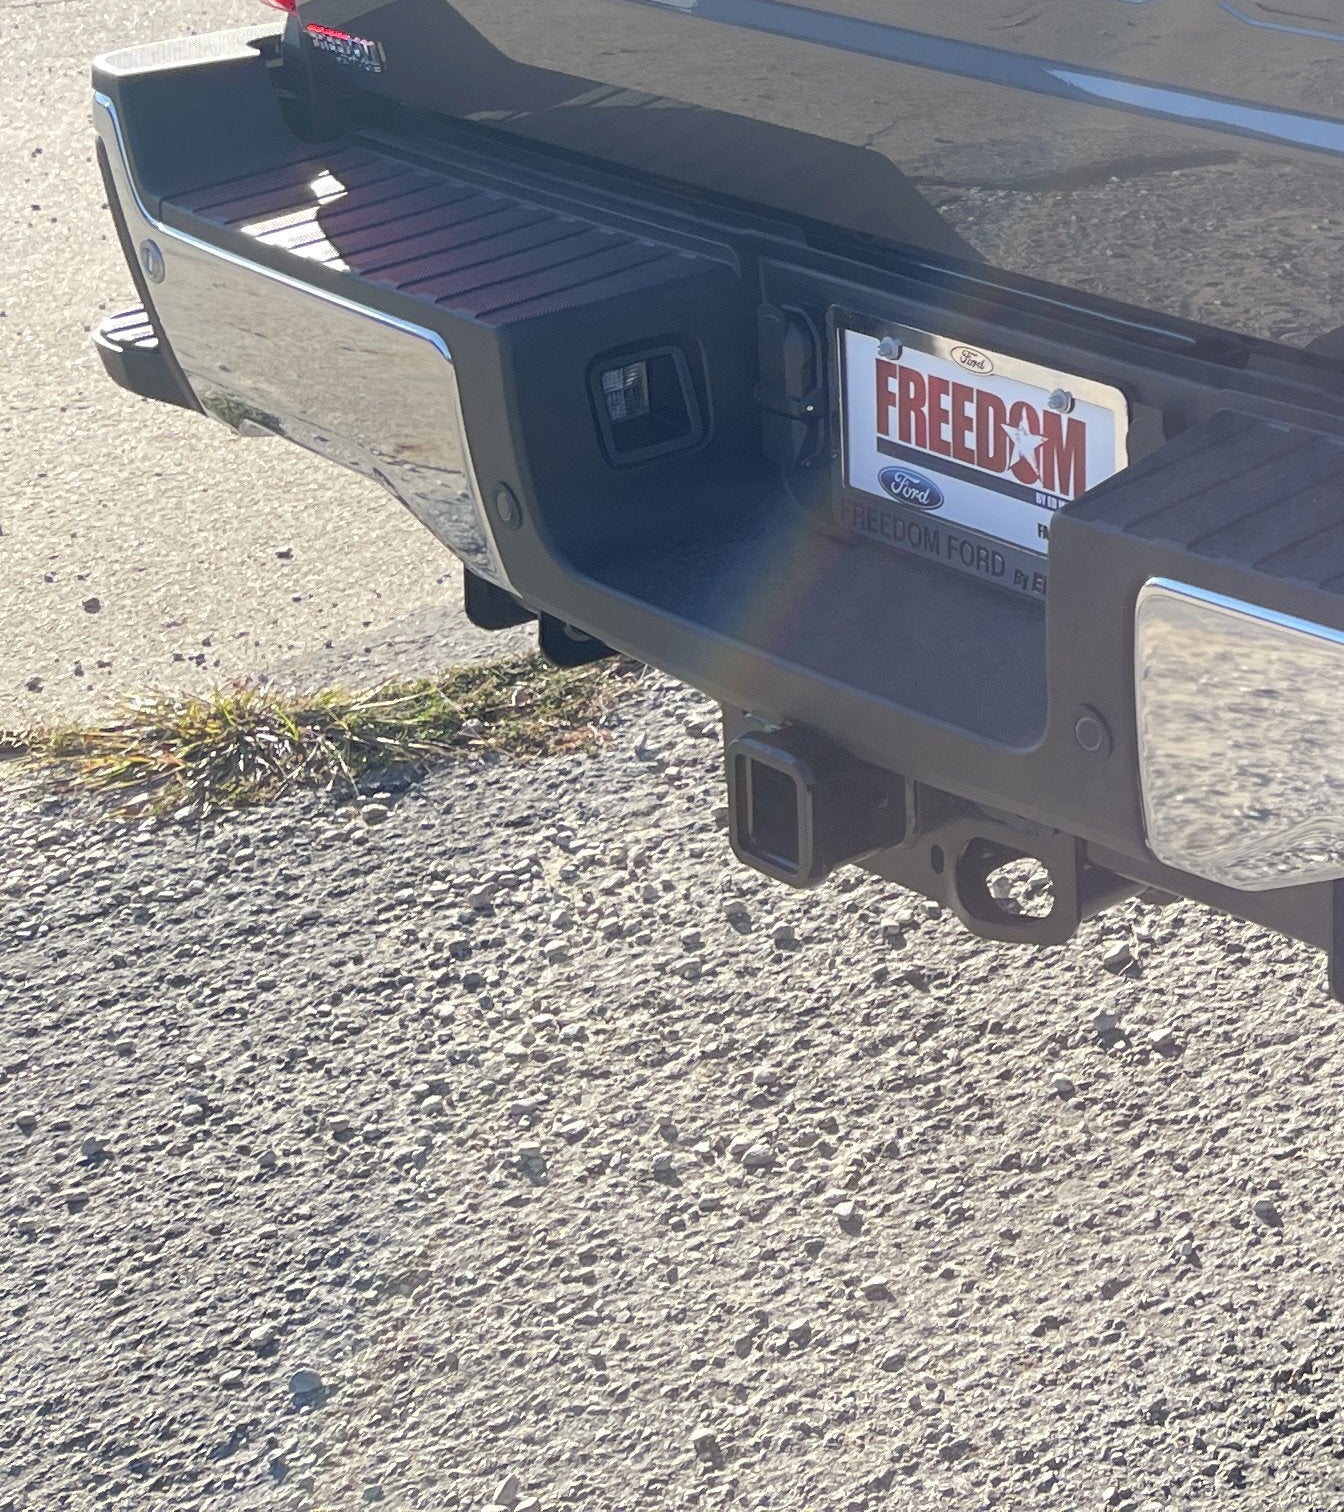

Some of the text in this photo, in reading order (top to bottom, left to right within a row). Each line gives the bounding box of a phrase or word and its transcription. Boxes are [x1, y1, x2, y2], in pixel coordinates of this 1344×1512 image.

[958, 349, 986, 371] Ford
[875, 358, 1087, 498] FREEDOM
[890, 472, 931, 505] Ford
[947, 535, 1007, 576] FORD
